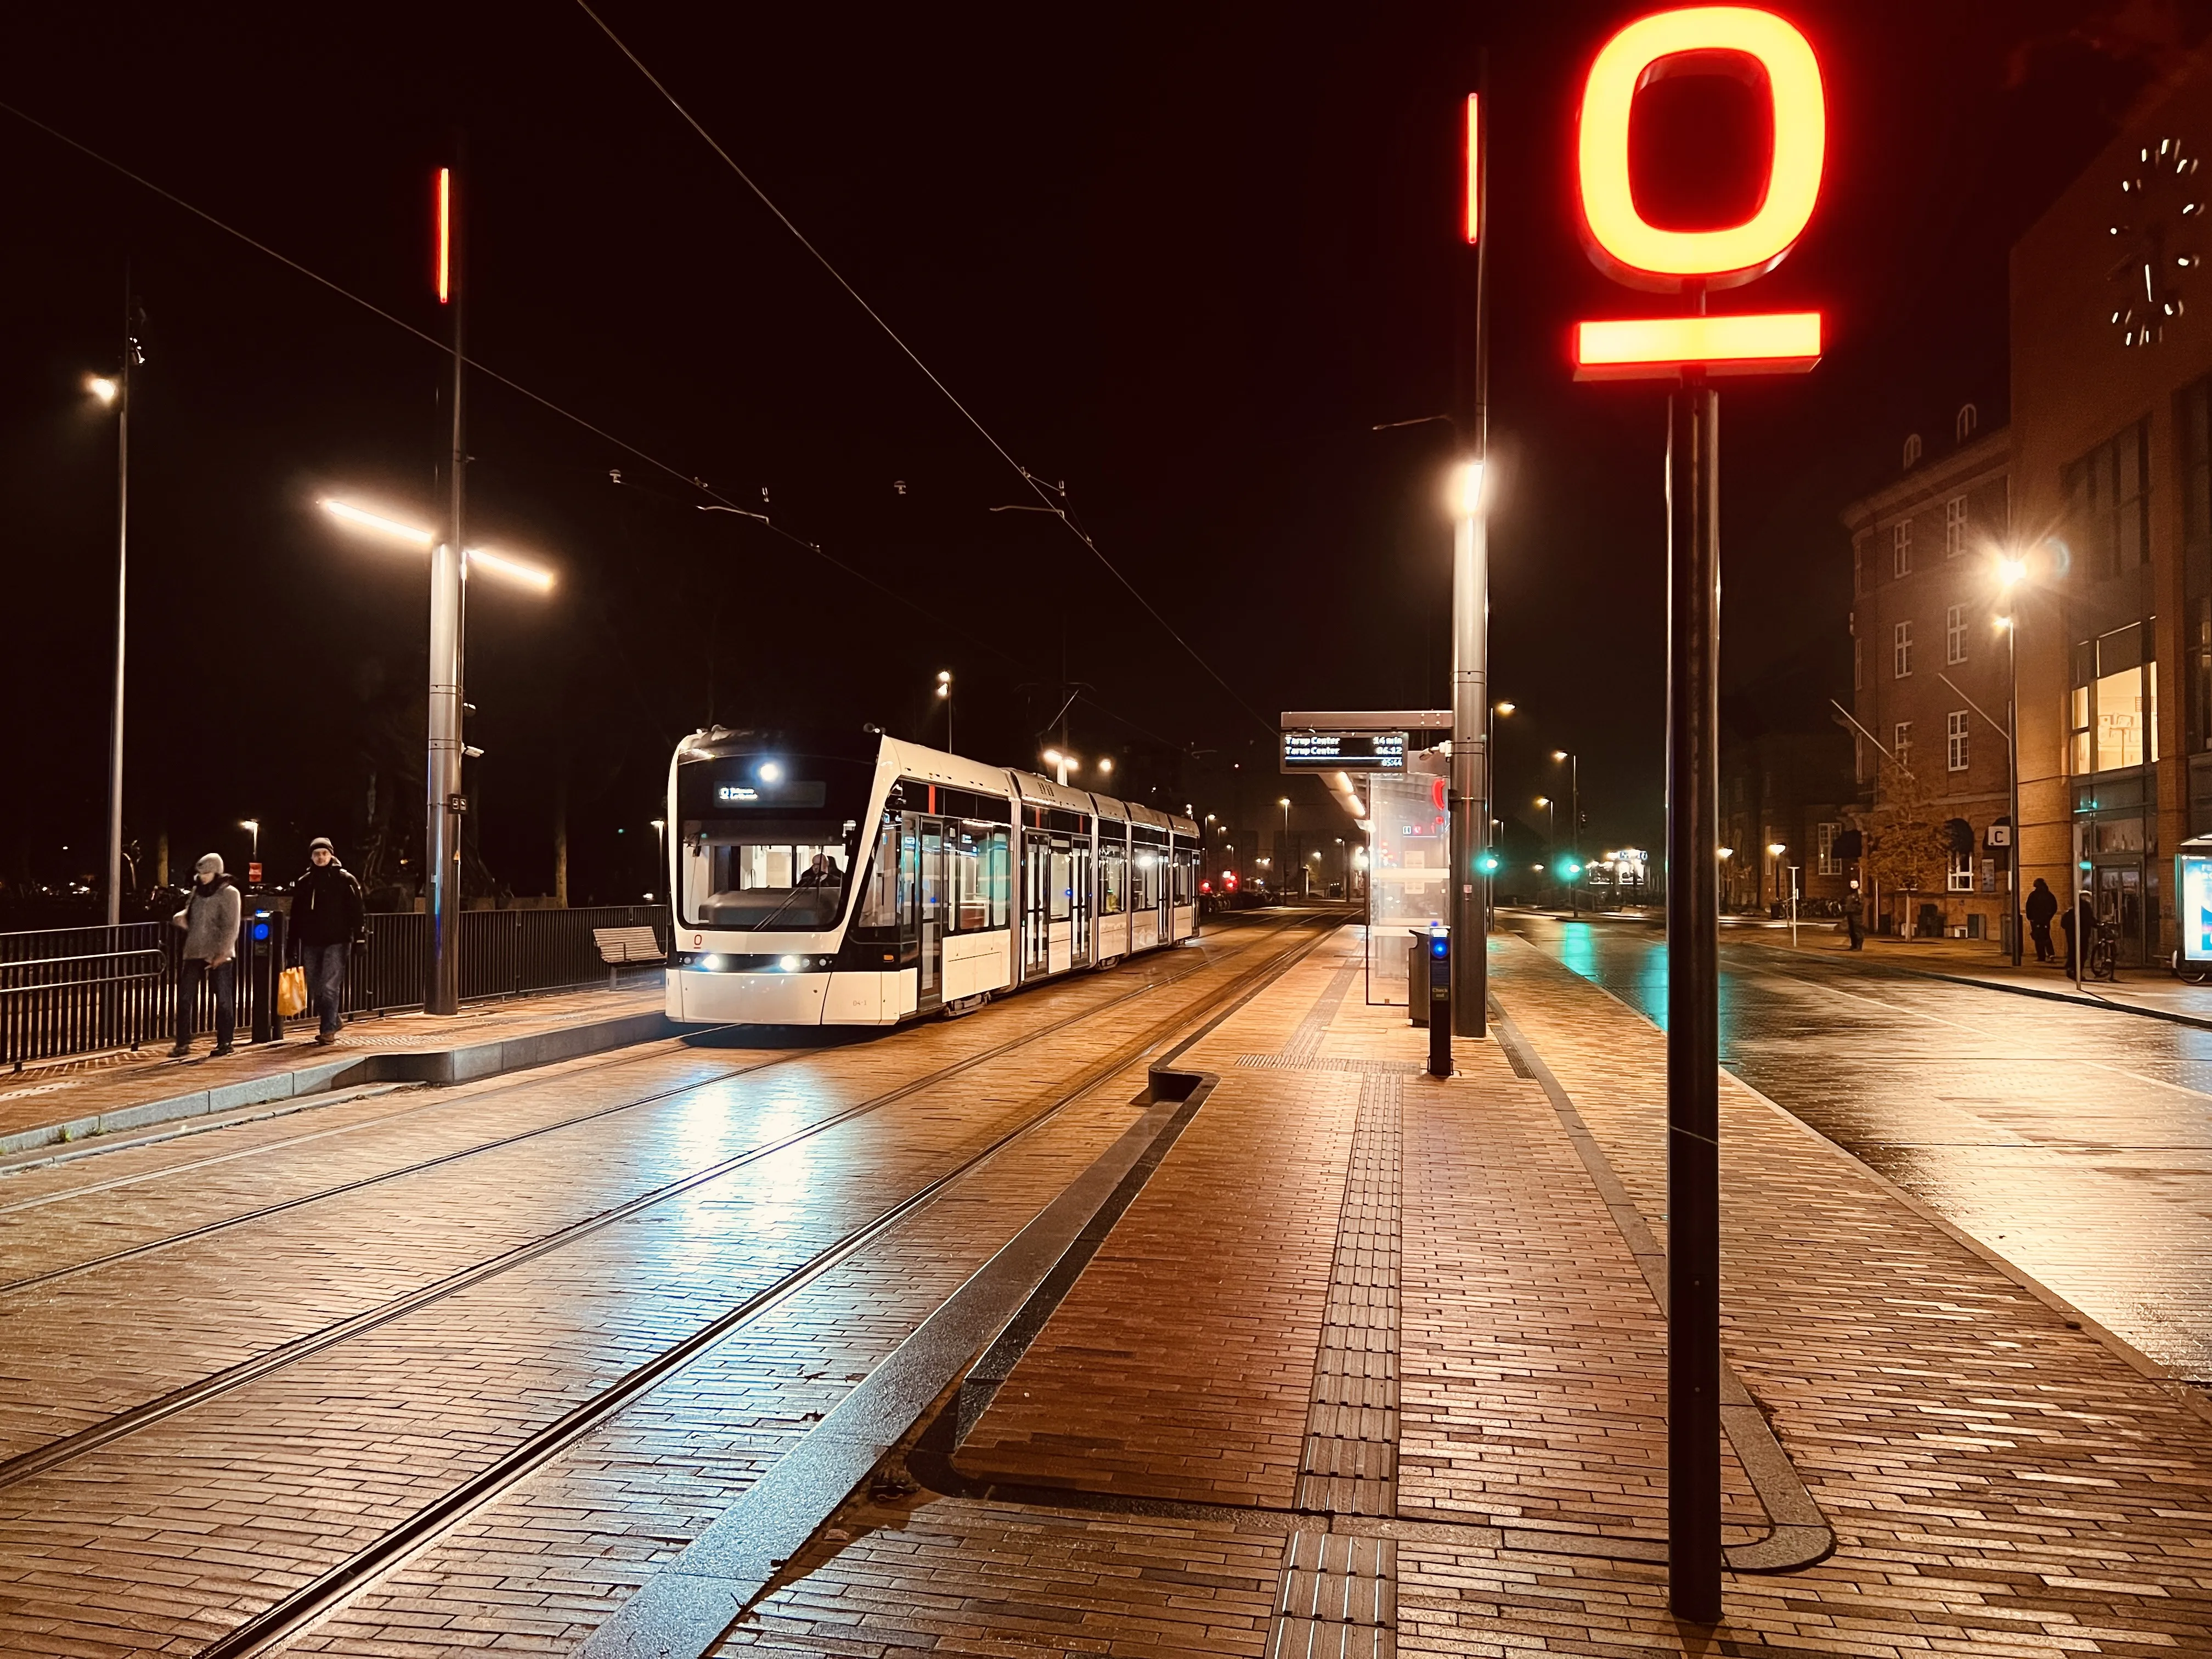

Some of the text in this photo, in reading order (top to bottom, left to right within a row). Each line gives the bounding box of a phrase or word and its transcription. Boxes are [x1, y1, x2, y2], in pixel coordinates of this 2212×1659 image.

[1311, 736, 1340, 745] Center
[1386, 736, 1403, 744] min
[1311, 746, 1340, 755] Center
